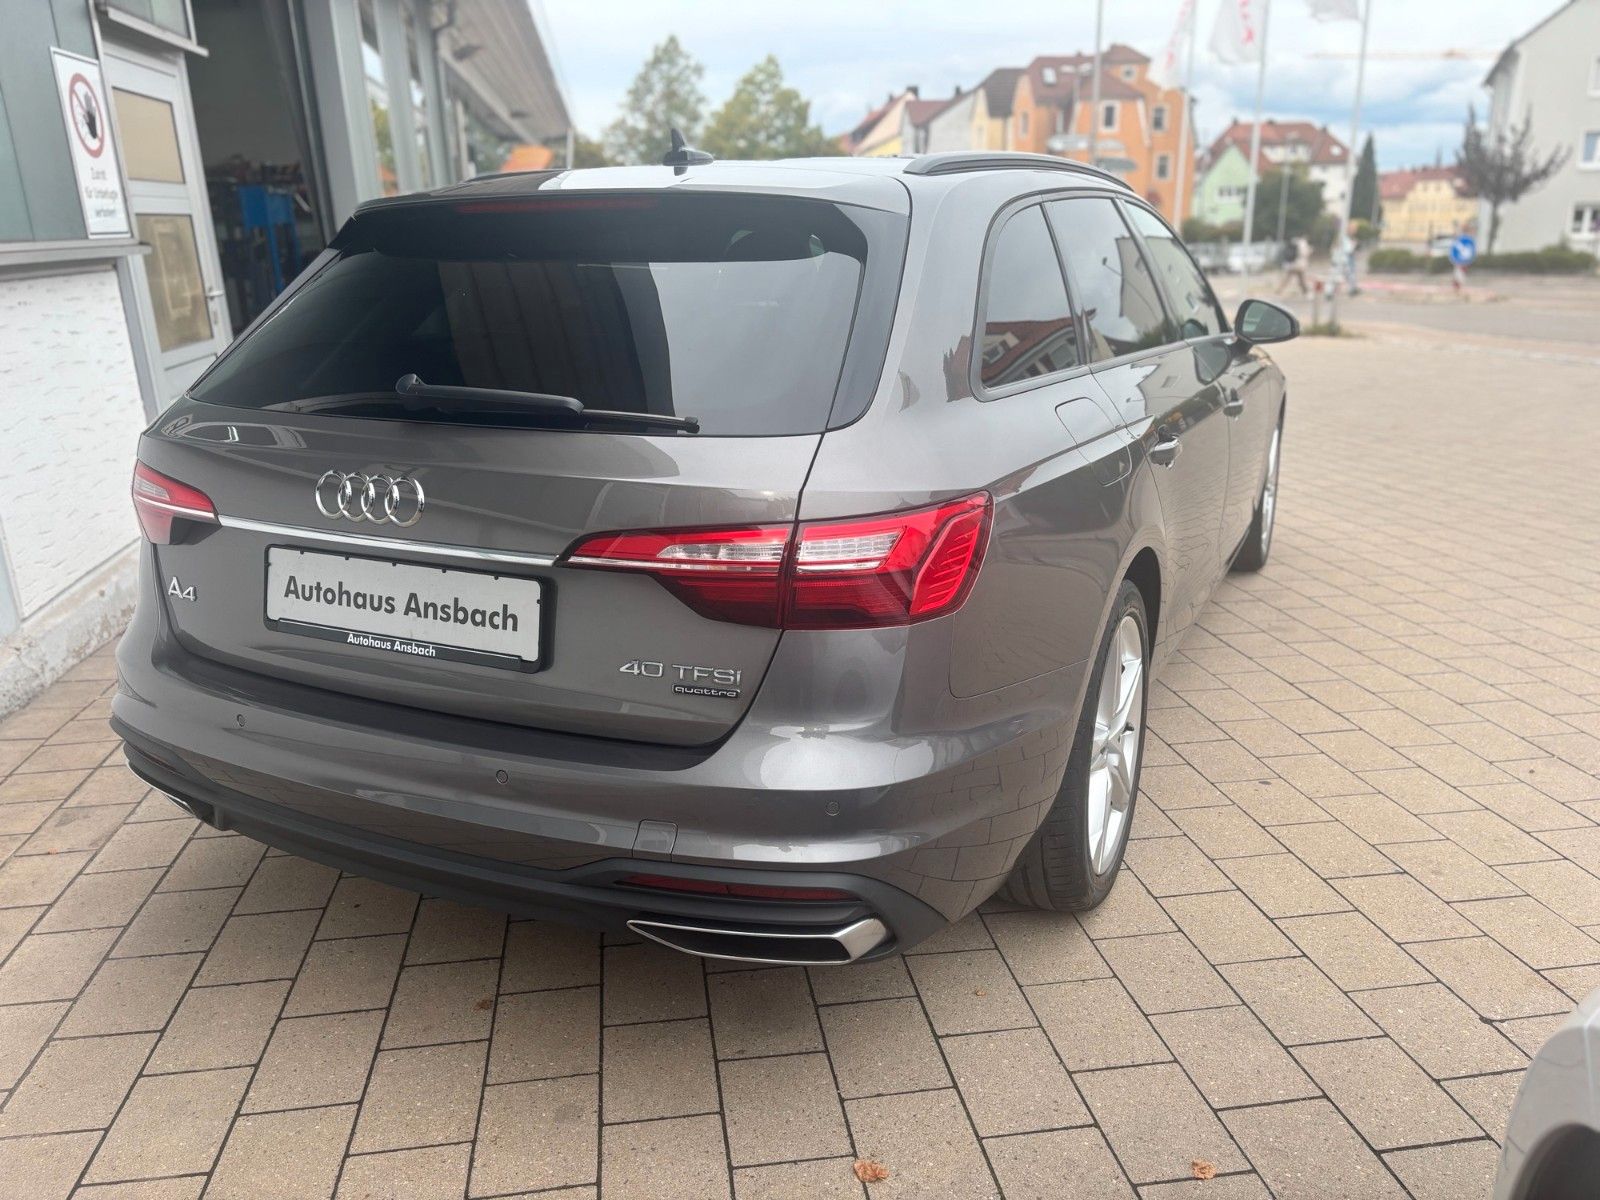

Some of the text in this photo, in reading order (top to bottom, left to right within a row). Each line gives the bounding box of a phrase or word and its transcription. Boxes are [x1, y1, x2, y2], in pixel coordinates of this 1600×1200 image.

[168, 576, 196, 601] A4
[284, 575, 518, 632] Autohaus Ansbach
[346, 633, 436, 657] Autohaus Ansbach
[619, 660, 741, 685] 40 TFSI
[675, 686, 737, 697] quattro
